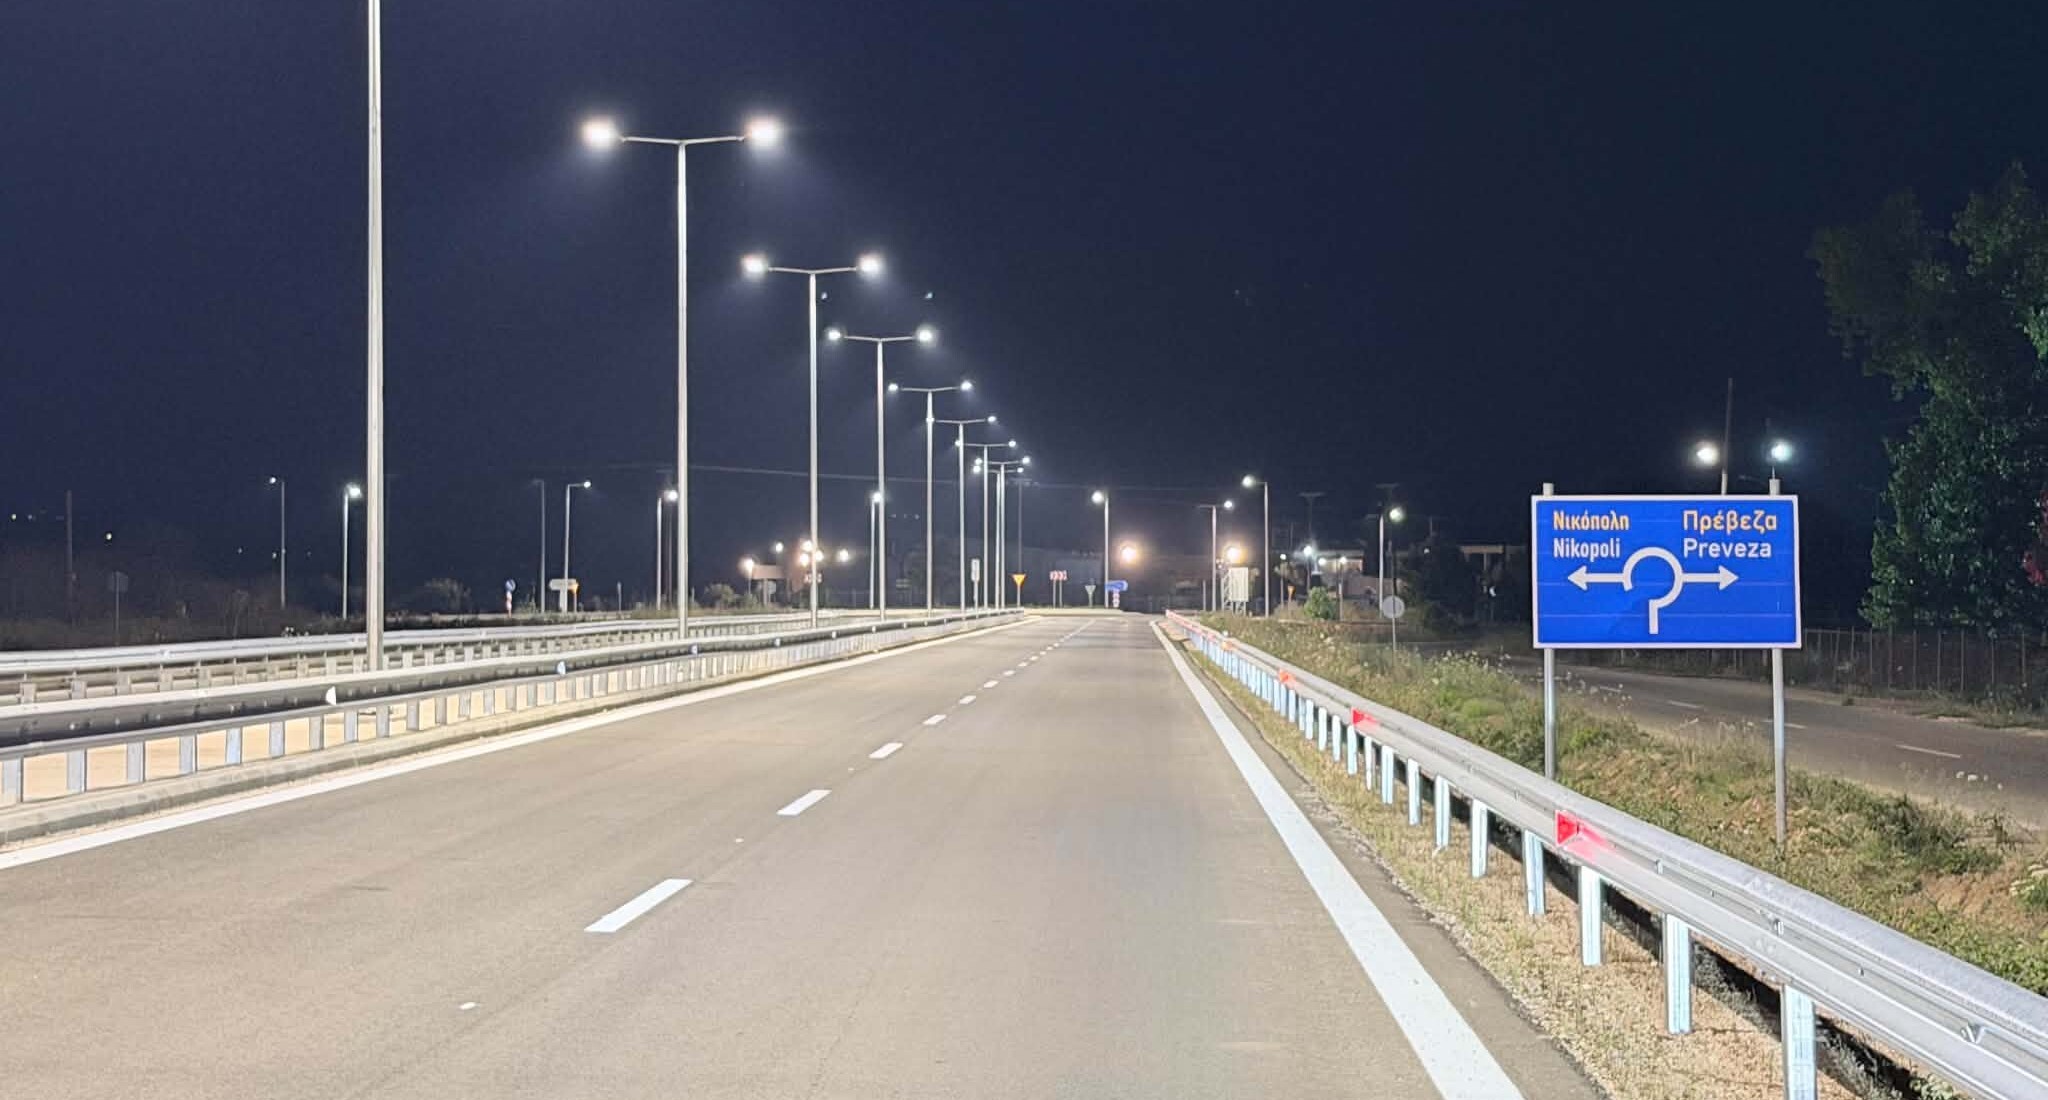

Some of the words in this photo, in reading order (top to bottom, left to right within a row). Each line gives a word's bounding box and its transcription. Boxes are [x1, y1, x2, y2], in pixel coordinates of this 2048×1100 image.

[1553, 509, 1630, 530] Νικόπολη
[1683, 509, 1777, 534] Πρέβεζα
[1553, 538, 1621, 562] Nikopoli
[1683, 538, 1772, 558] Preveza
